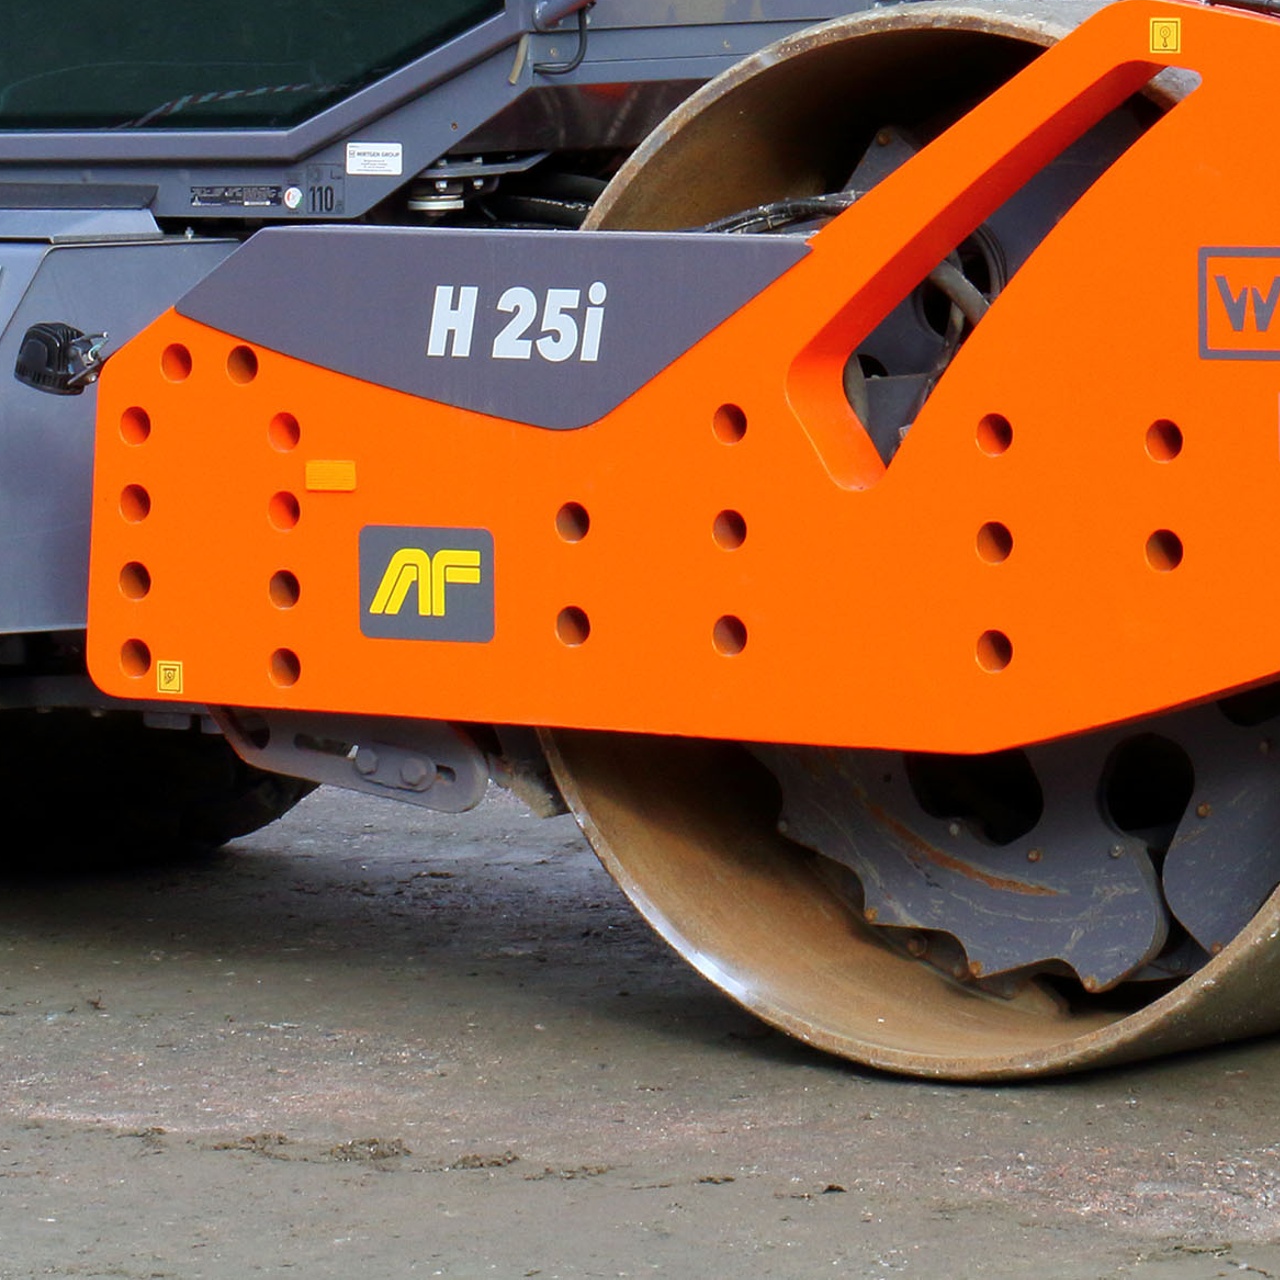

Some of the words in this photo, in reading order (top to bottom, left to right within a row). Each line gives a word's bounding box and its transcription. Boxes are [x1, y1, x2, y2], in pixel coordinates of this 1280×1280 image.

[309, 185, 334, 212] 110
[426, 284, 479, 358] H
[491, 280, 608, 363] 25i
[368, 548, 481, 617] AF
